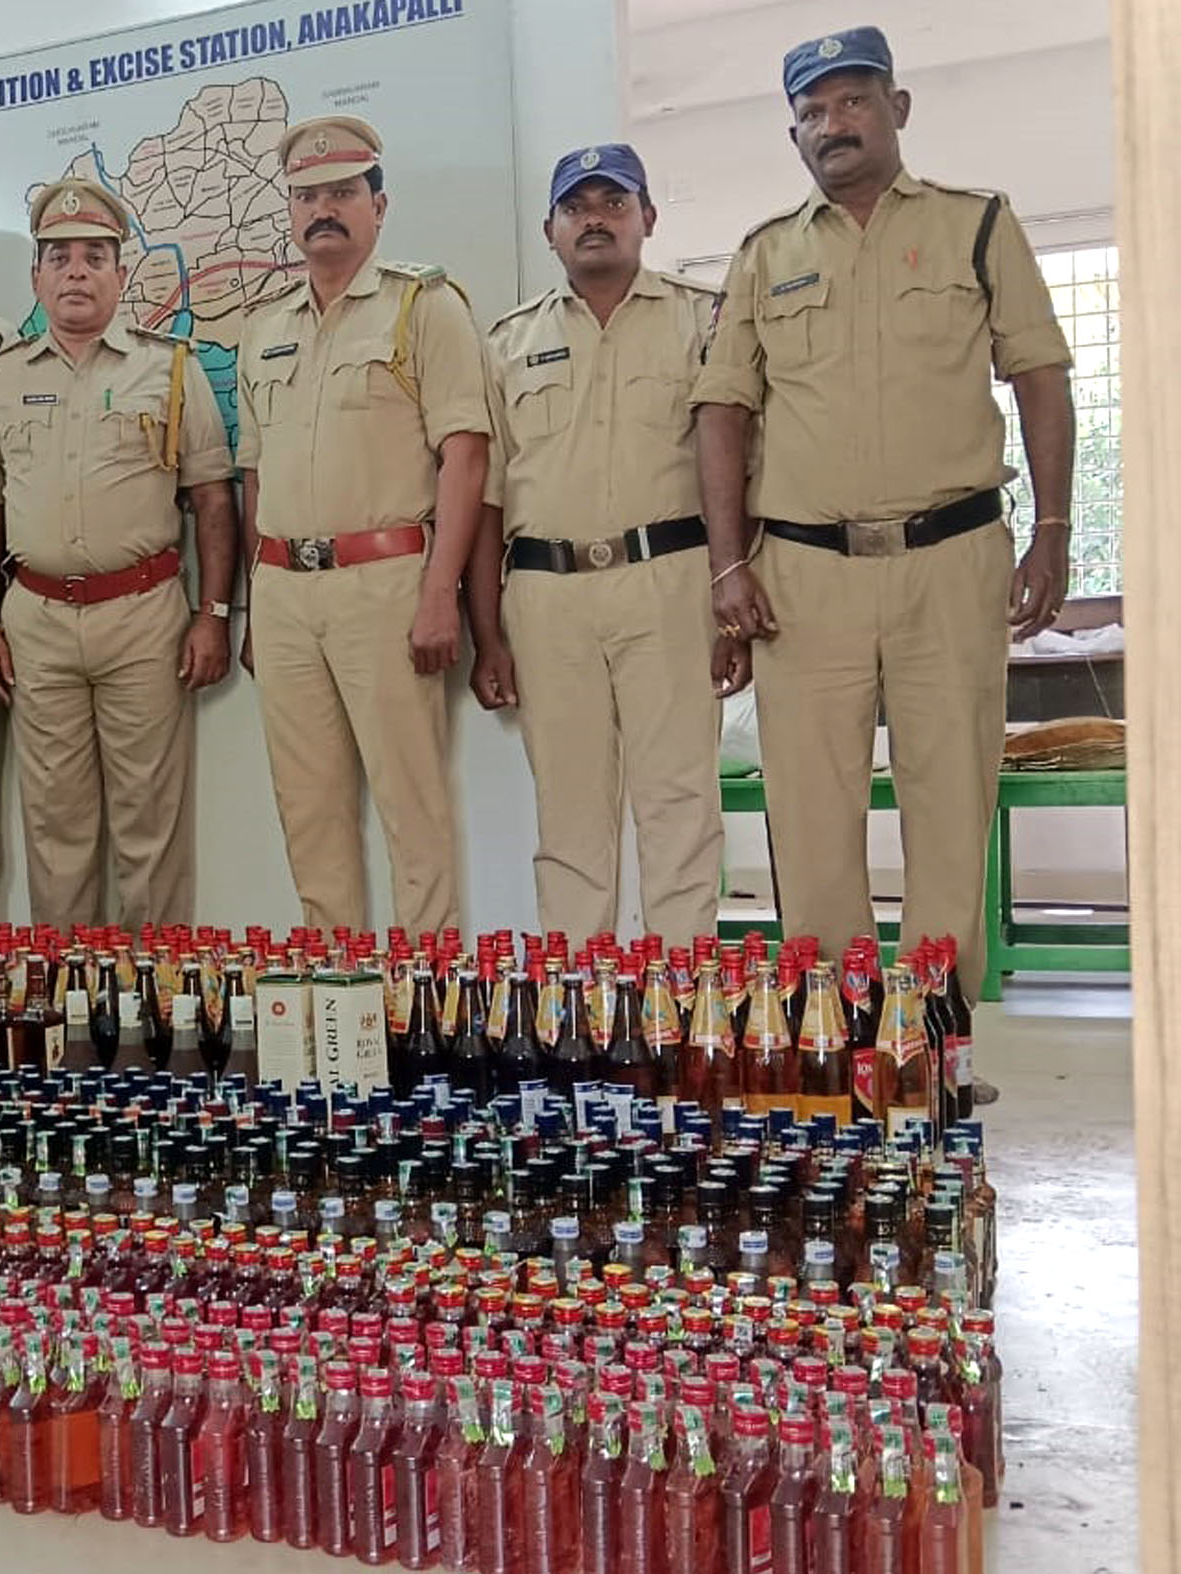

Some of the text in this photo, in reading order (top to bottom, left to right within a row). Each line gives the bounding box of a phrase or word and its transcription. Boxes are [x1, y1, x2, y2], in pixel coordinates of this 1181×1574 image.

[67, 68, 83, 92] &
[89, 44, 174, 88] EXCISE
[180, 19, 292, 69] STATION,
[325, 998, 340, 1062] GREEN
